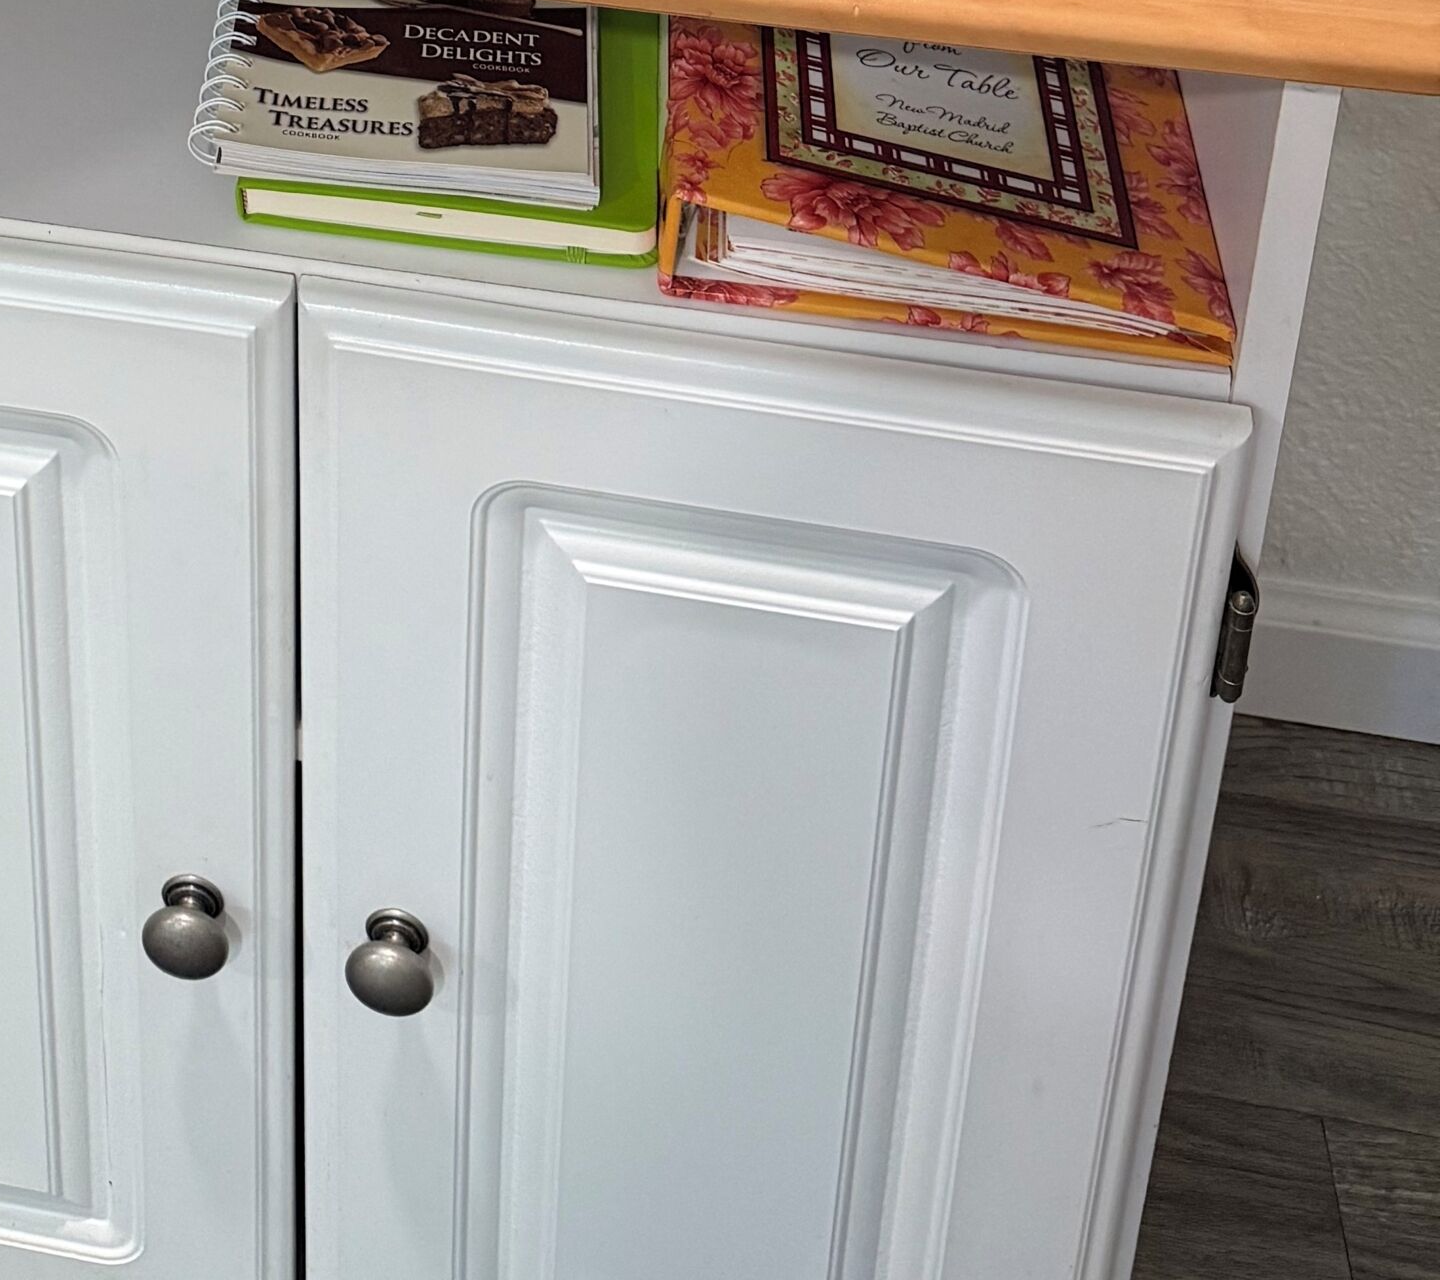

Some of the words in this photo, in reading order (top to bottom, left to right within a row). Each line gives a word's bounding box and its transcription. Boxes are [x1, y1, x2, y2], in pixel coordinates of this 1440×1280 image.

[404, 24, 540, 47] DECADENT
[421, 43, 542, 66] DELIGHTS
[472, 62, 530, 73] COOKBOOK
[856, 48, 930, 80] Our
[933, 64, 1019, 100] Table
[253, 87, 368, 113] TIMELESS
[268, 109, 414, 136] TREASURES
[875, 93, 926, 114] New
[925, 106, 1011, 134] Madrid
[282, 129, 340, 140] COOKBOOK
[876, 110, 947, 138] Baptist
[948, 130, 1014, 154] Church
